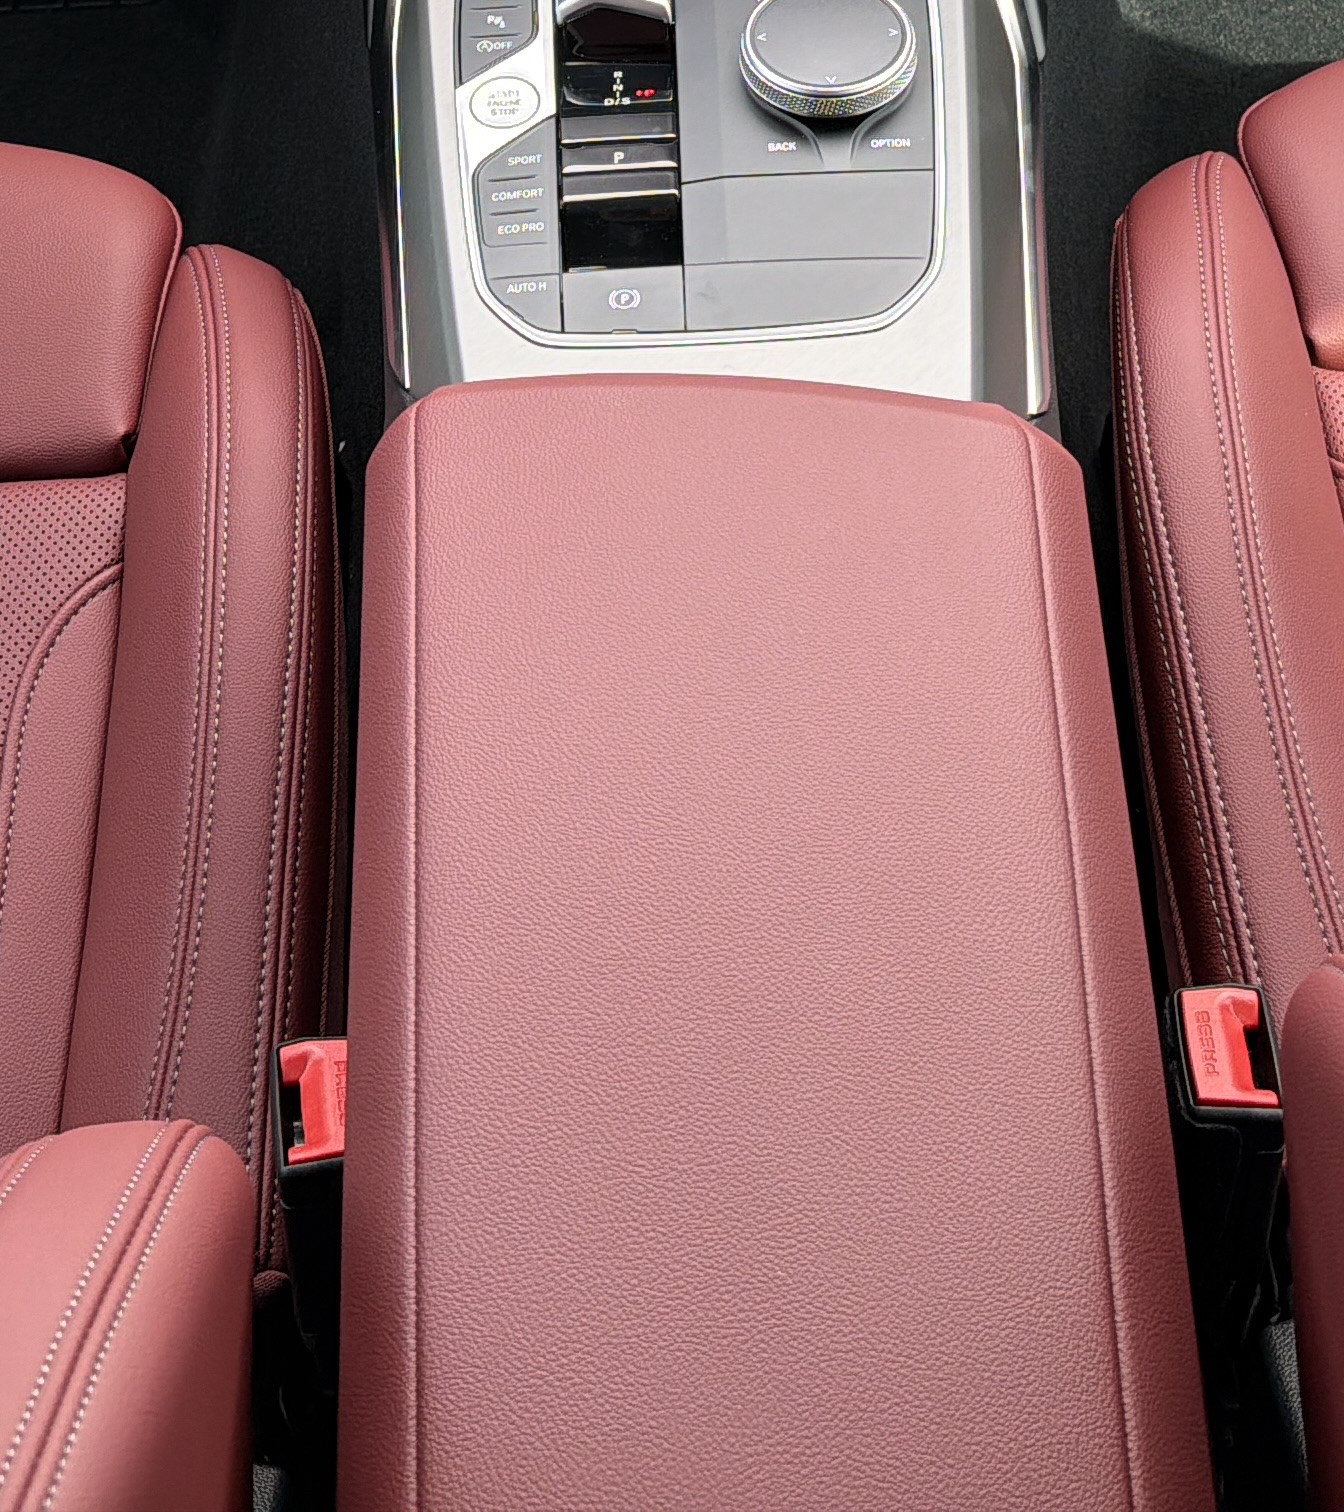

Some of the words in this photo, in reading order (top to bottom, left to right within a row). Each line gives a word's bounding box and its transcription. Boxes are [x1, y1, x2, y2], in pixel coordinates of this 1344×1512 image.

[493, 41, 513, 50] OFF
[767, 141, 797, 152] BACK
[870, 138, 911, 149] OPTION
[507, 154, 543, 166] SPORT
[613, 151, 625, 164] P
[491, 188, 545, 202] COMFORT
[497, 223, 521, 235] ECO
[522, 221, 545, 233] PRO
[506, 283, 537, 295] AUTO
[540, 281, 547, 291] H
[1194, 1010, 1220, 1076] PRESS
